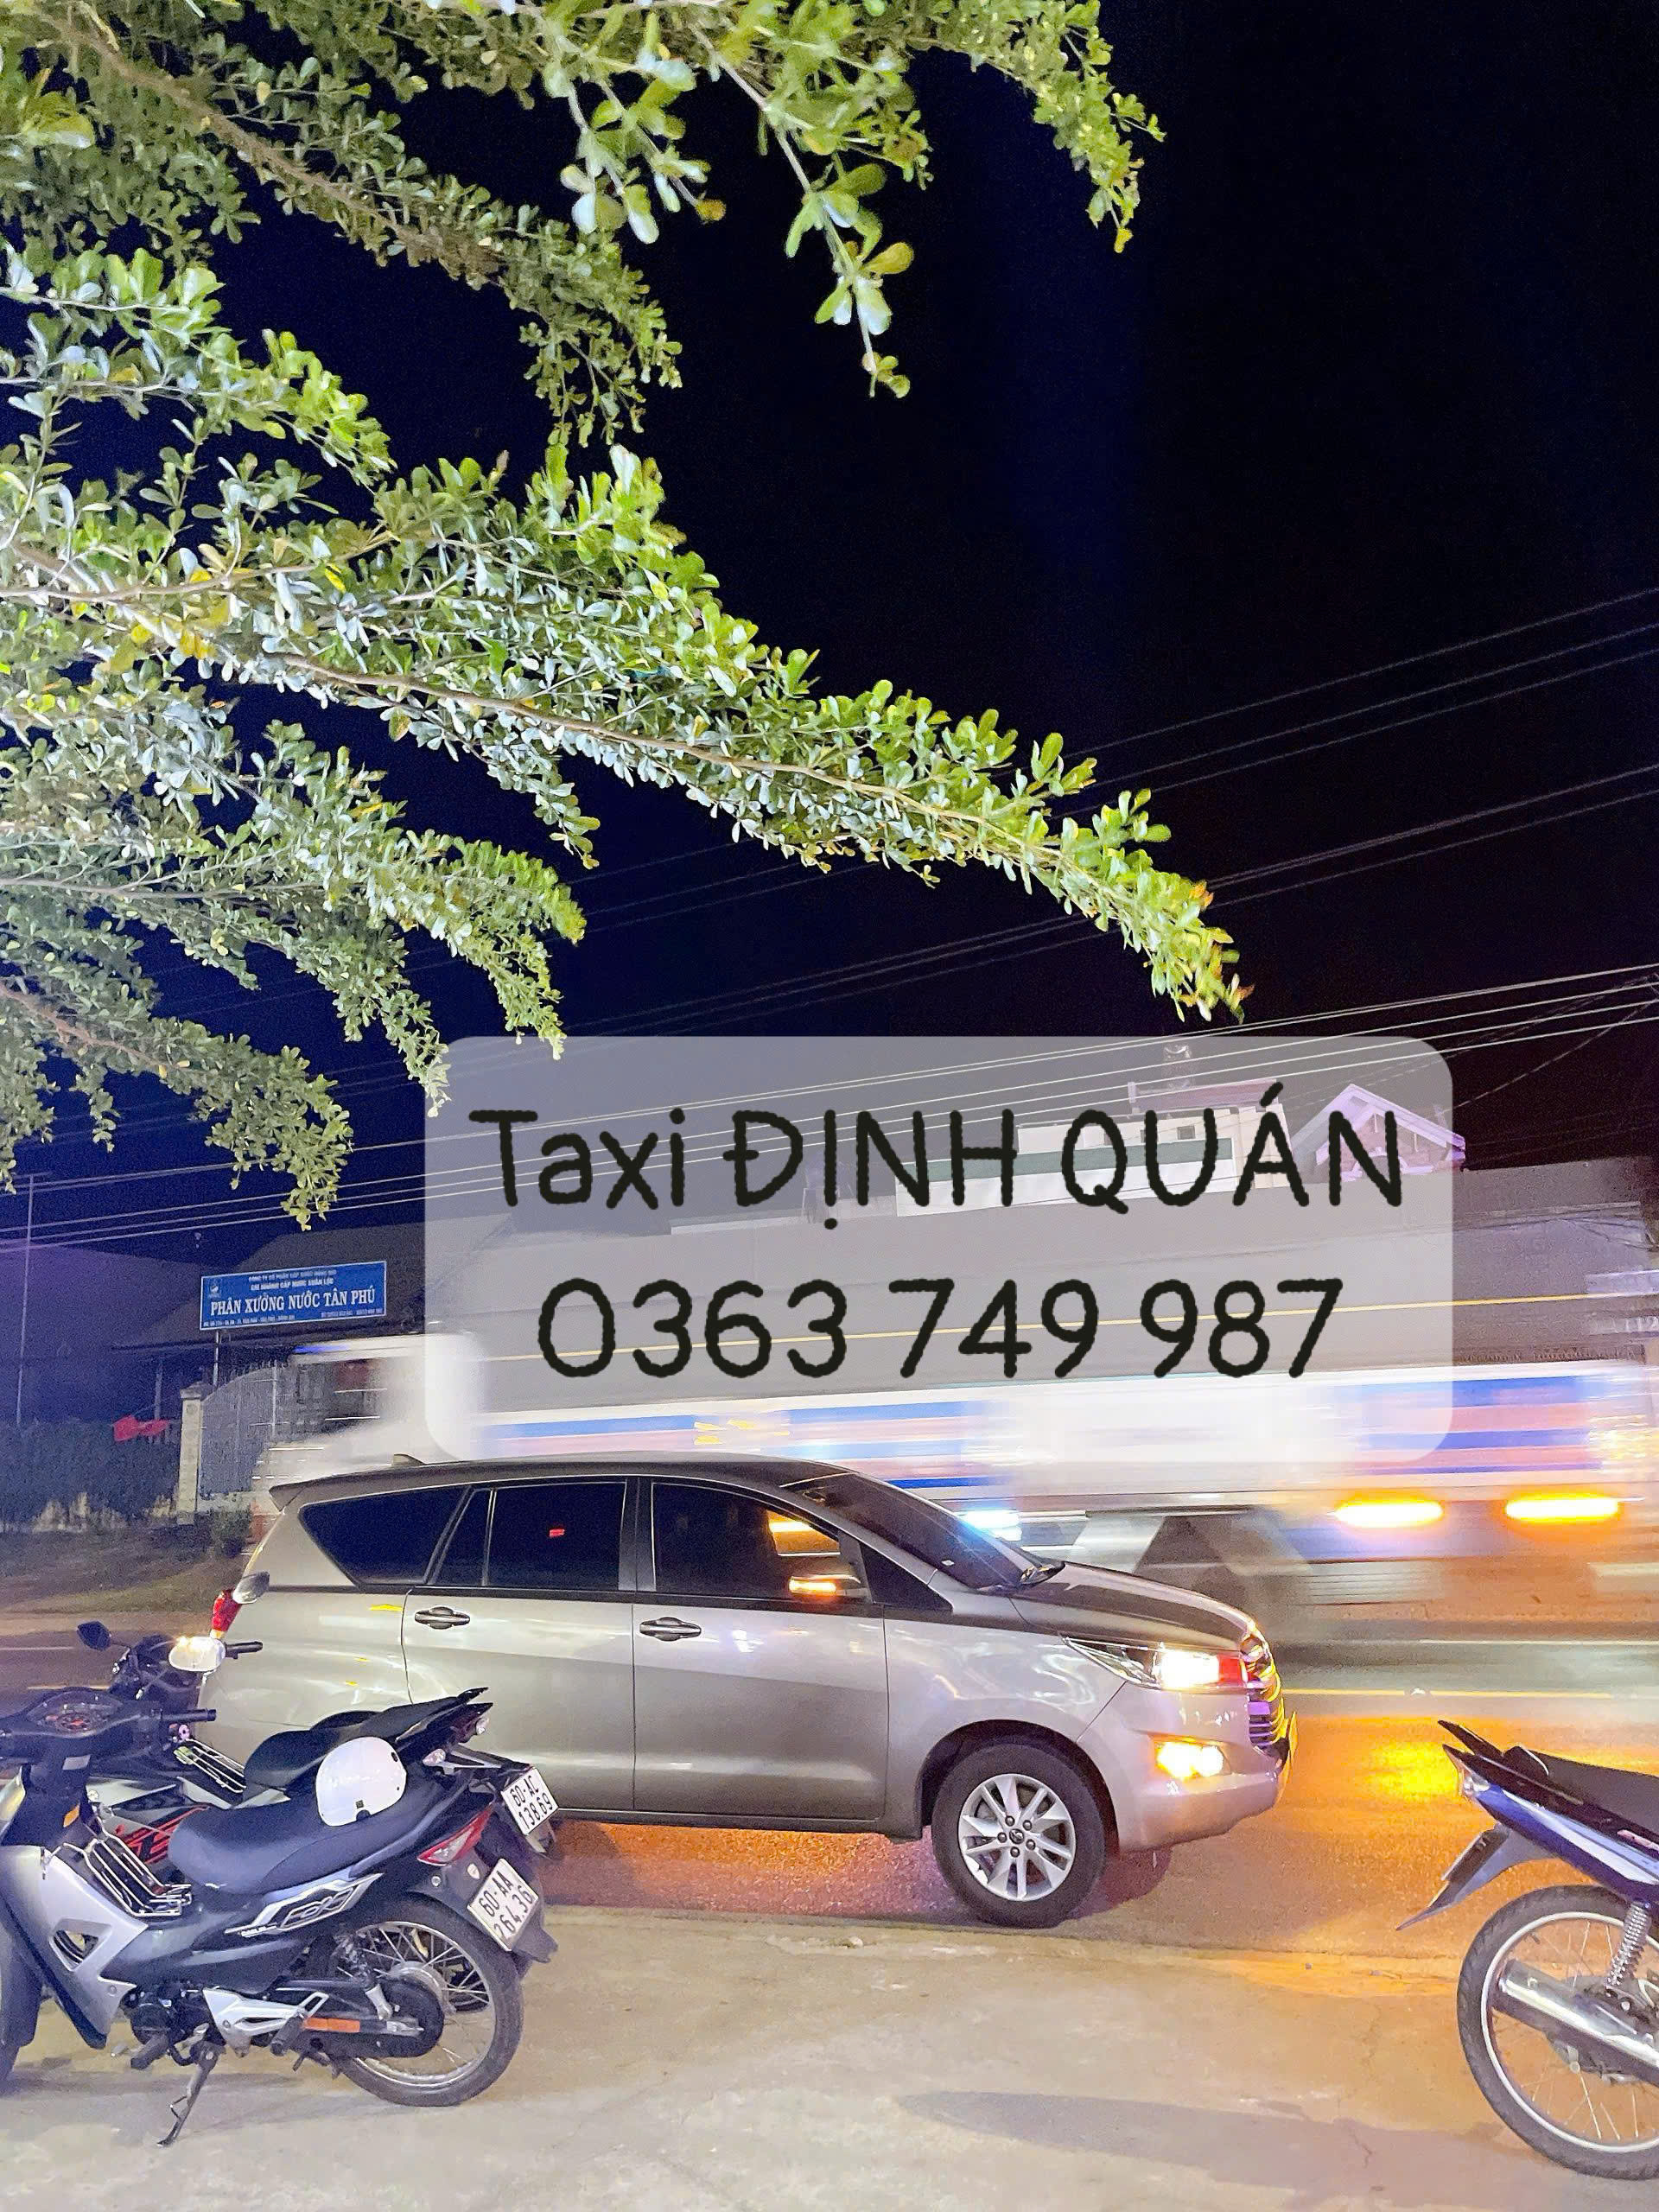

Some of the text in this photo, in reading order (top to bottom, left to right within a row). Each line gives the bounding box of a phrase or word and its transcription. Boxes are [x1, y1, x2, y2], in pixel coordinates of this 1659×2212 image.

[210, 1285, 376, 1316] PHÂN XƯỞNG NƯỚC TÂN PHÚ
